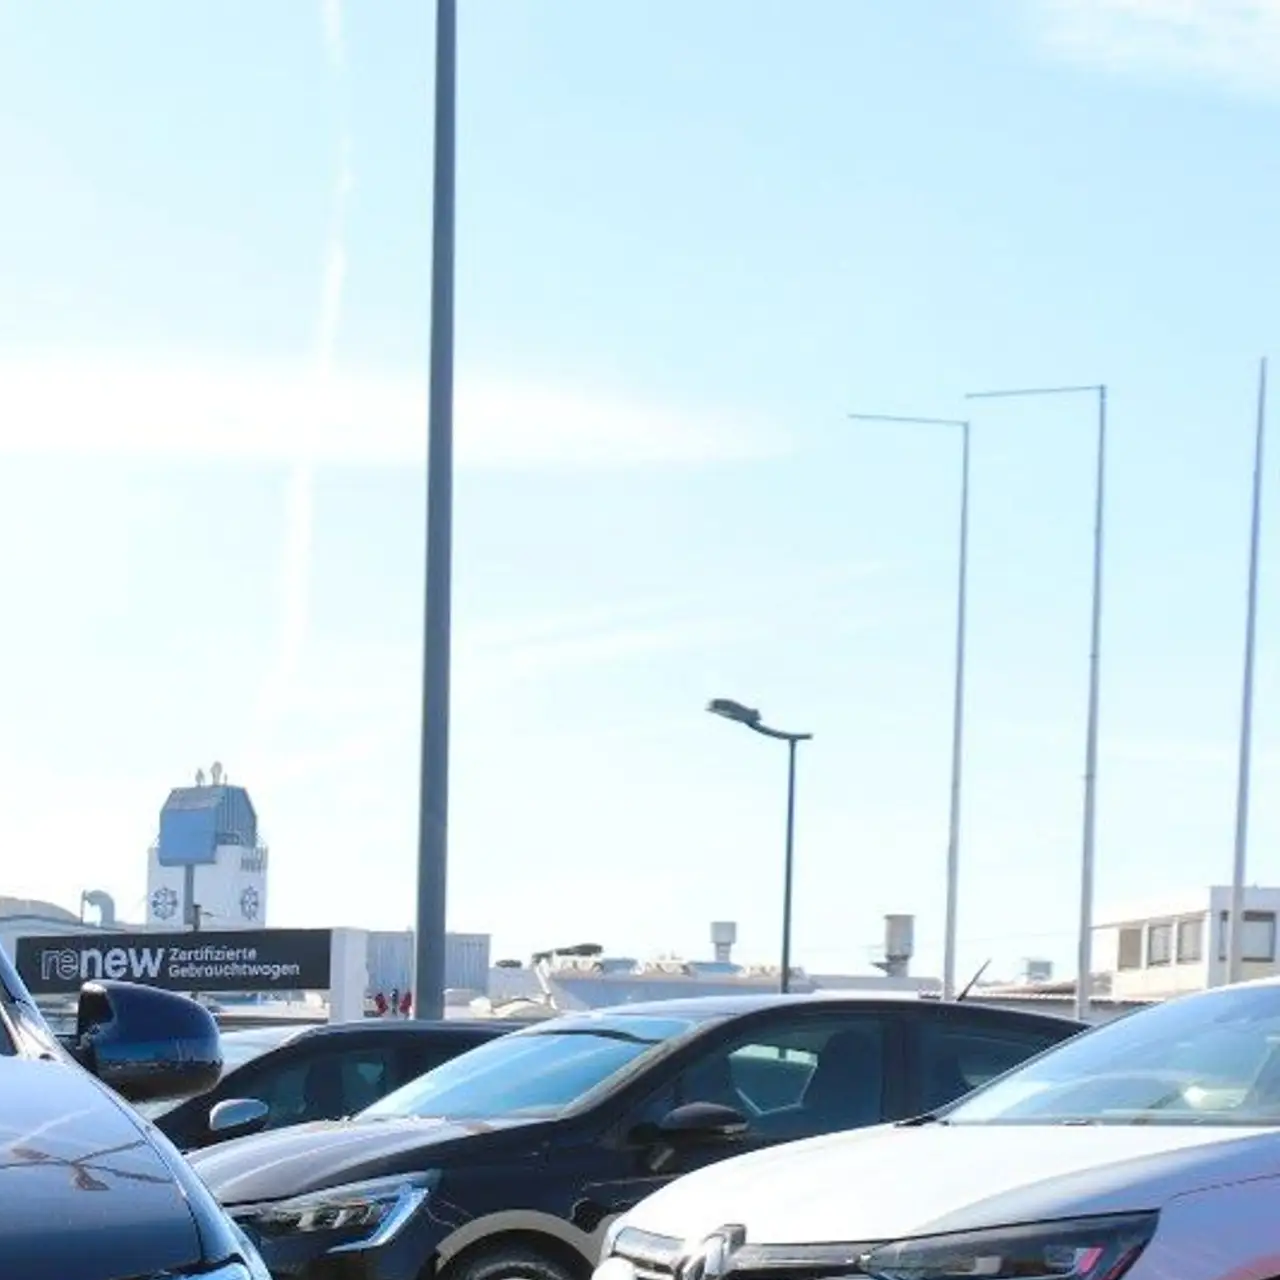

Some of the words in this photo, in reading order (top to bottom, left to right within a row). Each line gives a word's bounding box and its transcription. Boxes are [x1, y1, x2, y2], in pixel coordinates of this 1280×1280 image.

[168, 947, 257, 961] Zertifizierte
[42, 946, 164, 980] renew
[168, 962, 300, 979] Gebrauchtwagen
